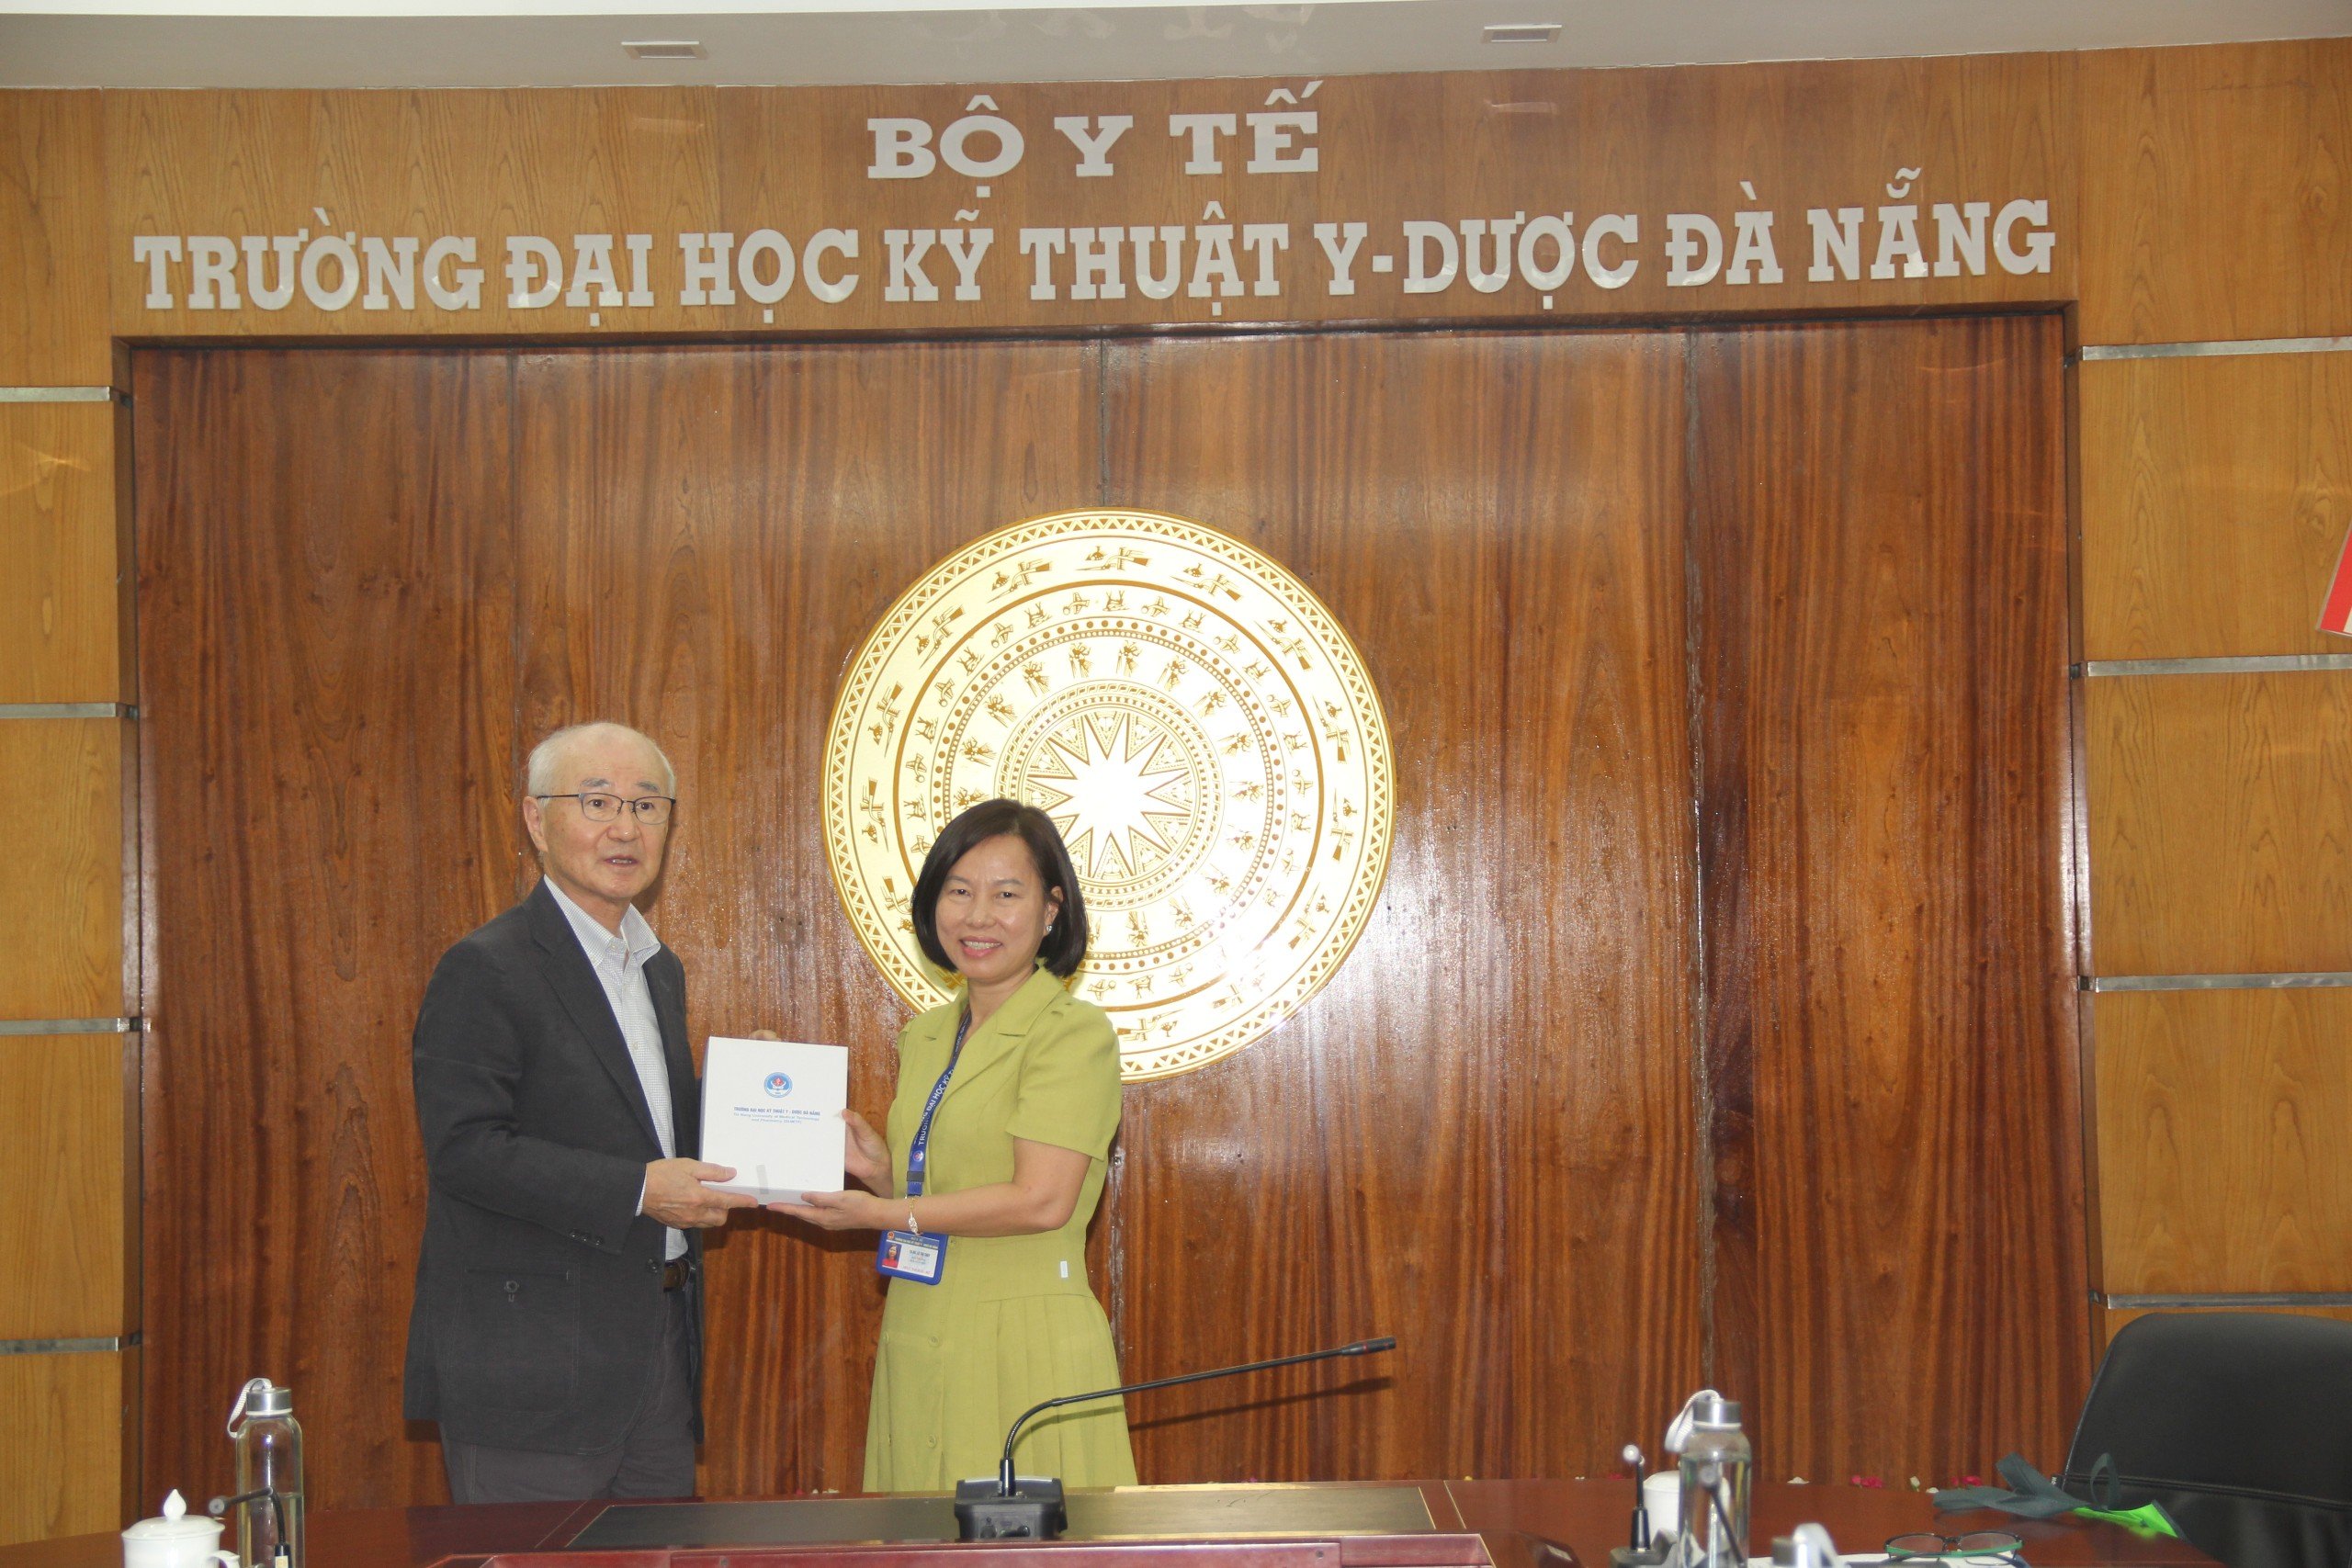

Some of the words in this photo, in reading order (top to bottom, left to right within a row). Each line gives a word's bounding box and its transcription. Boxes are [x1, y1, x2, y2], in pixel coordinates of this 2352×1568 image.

[867, 93, 1025, 197] BỘ
[1053, 113, 1135, 177] Y
[1169, 80, 1323, 175] TẾ
[133, 207, 485, 311] TRƯỜNG
[504, 233, 655, 326] ĐẠI
[678, 228, 859, 322] HỌC
[883, 209, 994, 302] KỸ
[1019, 200, 1290, 317] THUẬT
[1664, 180, 1784, 288] ĐÀ
[1806, 167, 2056, 282] NẴNG
